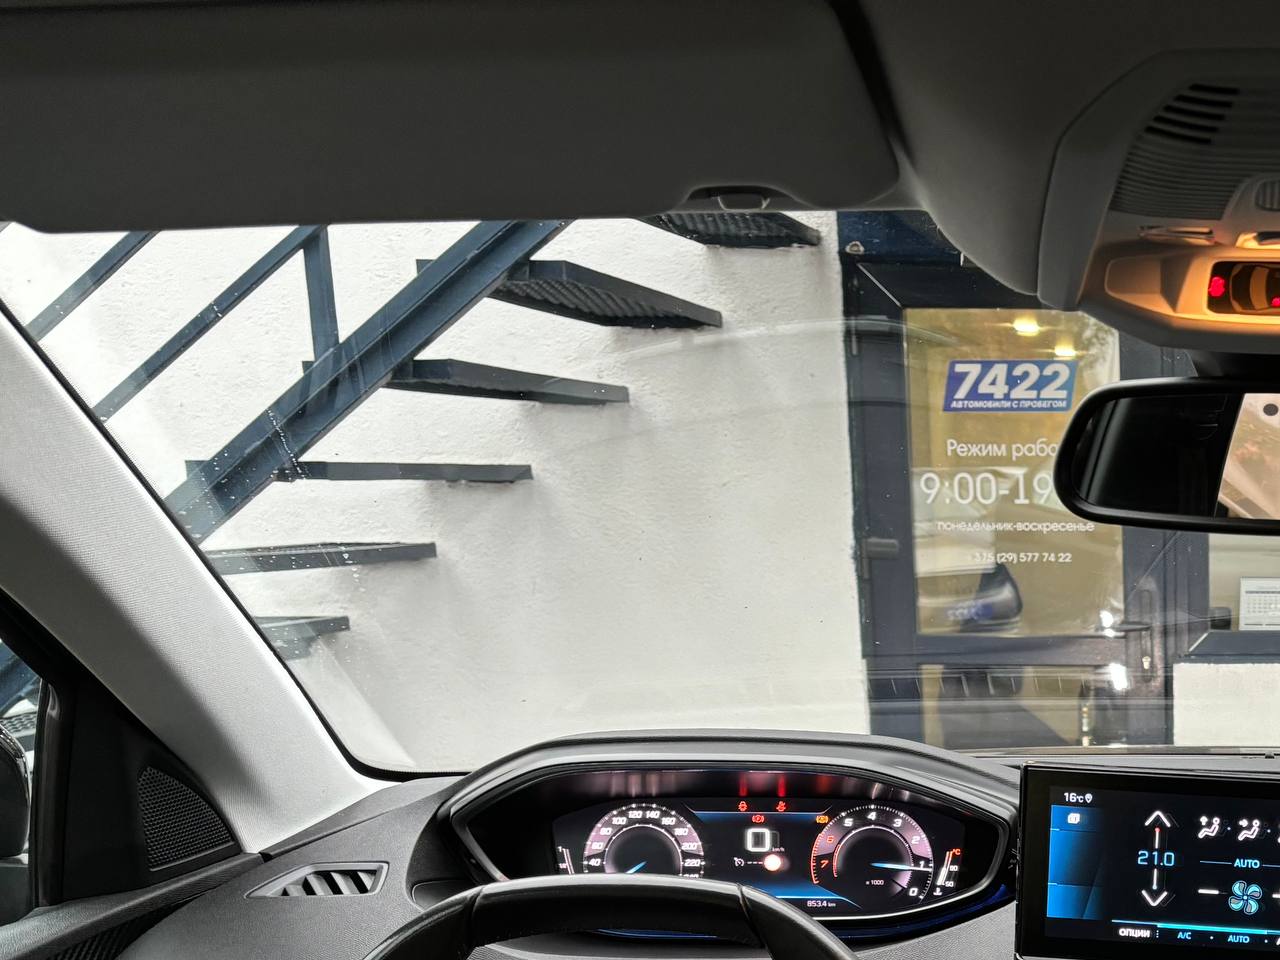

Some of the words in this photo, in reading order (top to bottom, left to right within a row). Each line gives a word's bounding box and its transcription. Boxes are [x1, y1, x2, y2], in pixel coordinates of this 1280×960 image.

[952, 362, 1071, 400] 7422
[950, 400, 1011, 409] АВТОМОБИЛИ
[1012, 400, 1019, 409] С
[1019, 400, 1068, 409] ПРОБЕГОМ
[946, 438, 1008, 458] Режим
[1011, 438, 1061, 462] рабо
[919, 472, 1055, 505] 9:00-19
[937, 520, 1096, 534] понедельник-воскресенье
[996, 552, 1018, 565] (29)
[1019, 552, 1040, 564] 577
[1041, 552, 1057, 564] 74
[1057, 552, 1073, 564] 22
[611, 817, 628, 825] 100
[867, 811, 877, 821] 4
[843, 818, 854, 827] 5
[892, 818, 903, 827] 3
[746, 828, 770, 852] 0
[911, 836, 921, 844] 2
[588, 858, 601, 867] 40
[684, 859, 701, 867] 220
[820, 860, 830, 868] 7
[1137, 850, 1175, 868] 21.0
[1233, 858, 1260, 869] AUTO
[909, 887, 918, 897] 0
[1119, 928, 1151, 938] ОПЦИИ
[1177, 931, 1192, 940] A/C
[1227, 934, 1250, 944] AUTO
